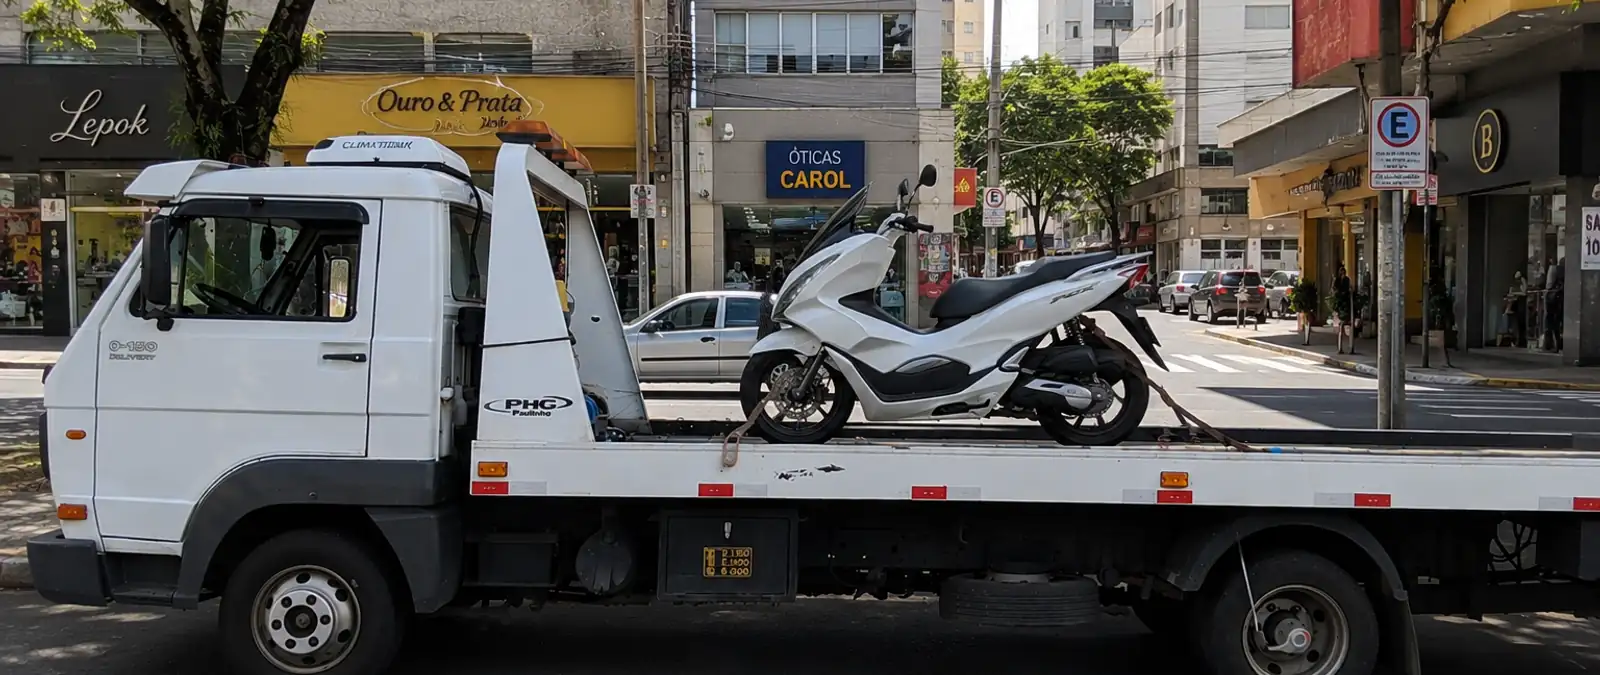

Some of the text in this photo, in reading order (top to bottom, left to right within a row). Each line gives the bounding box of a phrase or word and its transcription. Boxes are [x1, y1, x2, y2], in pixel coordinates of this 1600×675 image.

[377, 89, 522, 112] Ouro & Prata
[50, 89, 150, 147] Lepok
[1391, 112, 1409, 138] E
[1480, 124, 1493, 158] B
[789, 146, 841, 165] ÓTICAS
[780, 170, 852, 189] CAROL
[990, 191, 999, 203] E
[505, 399, 557, 410] PHG
[512, 409, 552, 417] Paulinho
